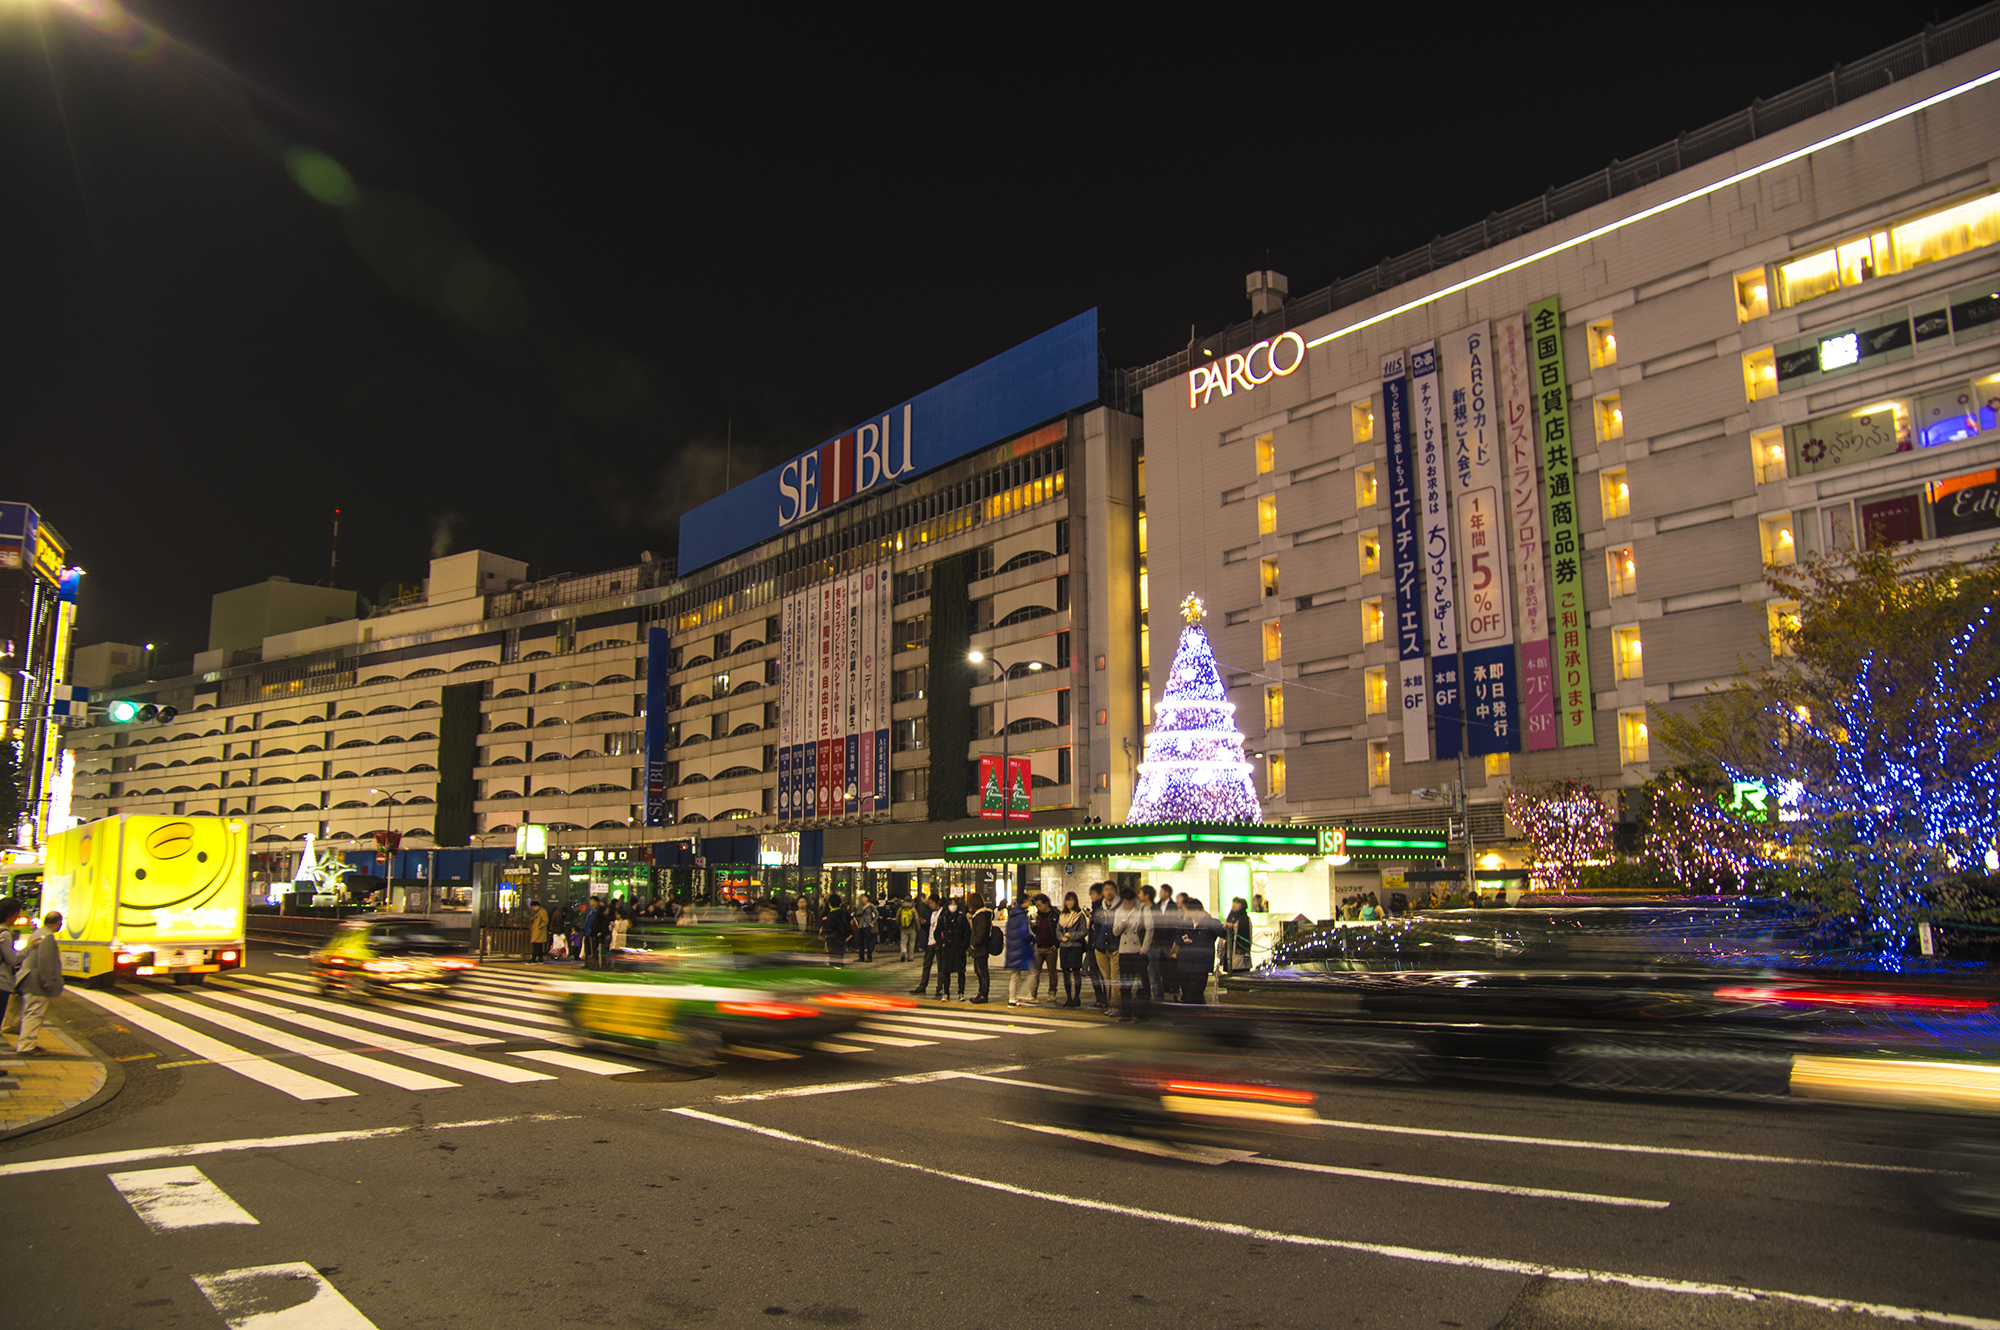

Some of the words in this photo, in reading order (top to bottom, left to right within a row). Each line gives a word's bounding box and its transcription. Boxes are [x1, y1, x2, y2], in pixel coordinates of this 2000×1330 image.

[1188, 330, 1305, 410] PARCO
[1413, 352, 1434, 369] ぴあ
[1390, 382, 1405, 487] もっと世界を楽しもう
[1421, 382, 1439, 514] チケットぴあのお求めは
[1453, 387, 1472, 487] 新規ご入会で
[1534, 308, 1577, 584] 全国百貨店共通商品券
[778, 403, 916, 527] SEIBU
[1509, 401, 1536, 562] レストランフロア
[1470, 497, 1486, 549] 1年間
[1394, 487, 1420, 655] エイチ・アイ・エス
[1428, 524, 1452, 649] ちけっとぽーと
[1470, 613, 1500, 634] OFF
[1526, 585, 1538, 633] 夜23時まで
[833, 587, 841, 735] 有名ブランドスペシャルセール
[1404, 675, 1423, 688] 本館
[1435, 671, 1456, 684] 本館
[1527, 657, 1548, 670] 本館
[1561, 592, 1585, 726] ご利用承ります
[821, 675, 829, 736] 自由自在
[1404, 693, 1424, 710] 6F
[1436, 688, 1457, 706] 6F
[1474, 665, 1489, 720] 承り中
[1489, 663, 1508, 737] 即日発行
[648, 760, 664, 816] SEIBU
[1729, 780, 1768, 812] JR
[1042, 832, 1067, 855] ISP
[1319, 830, 1344, 853] ISP
